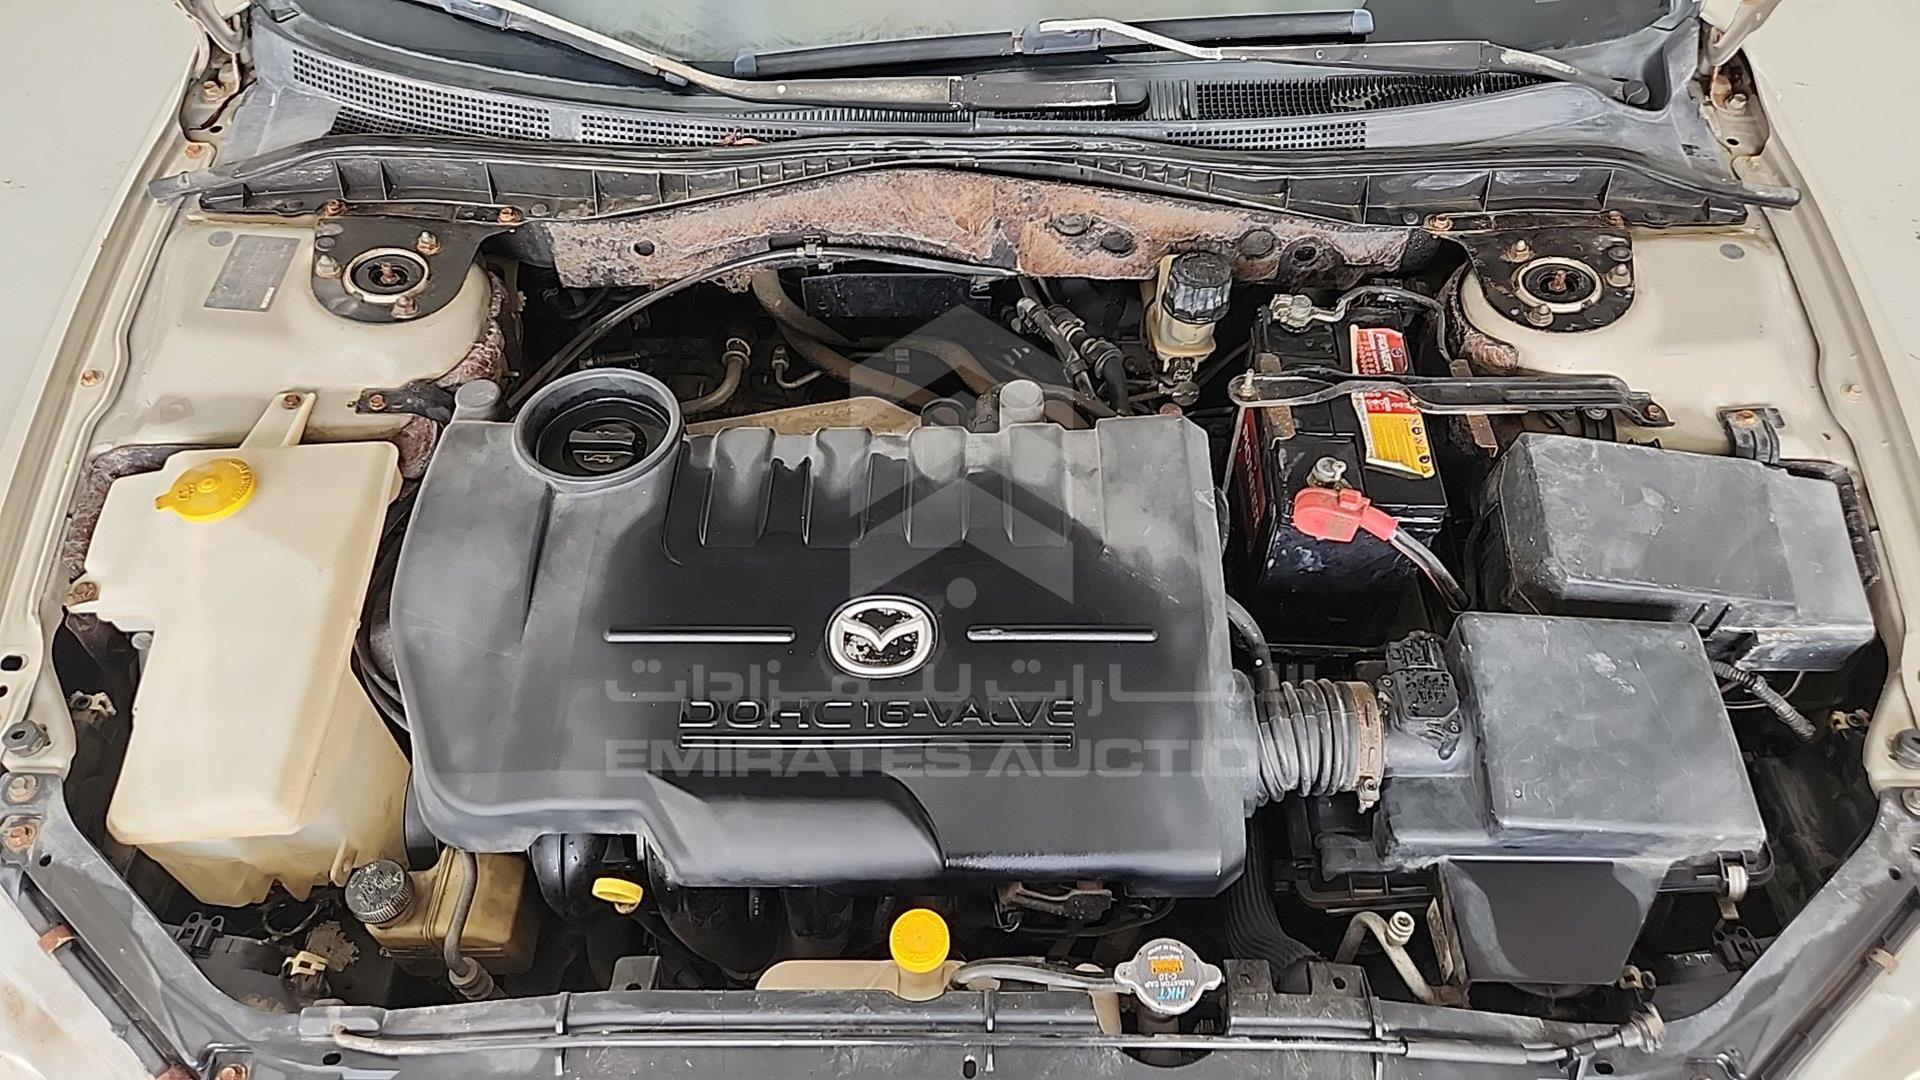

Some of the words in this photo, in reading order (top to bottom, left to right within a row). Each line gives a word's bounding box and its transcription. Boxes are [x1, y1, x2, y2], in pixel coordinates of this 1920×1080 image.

[678, 698, 851, 729] DOHC
[862, 697, 1076, 728] 16-VALVE
[1145, 980, 1160, 989] CAP
[1161, 979, 1195, 988] RADIATOR
[1156, 986, 1186, 1000] HKT
